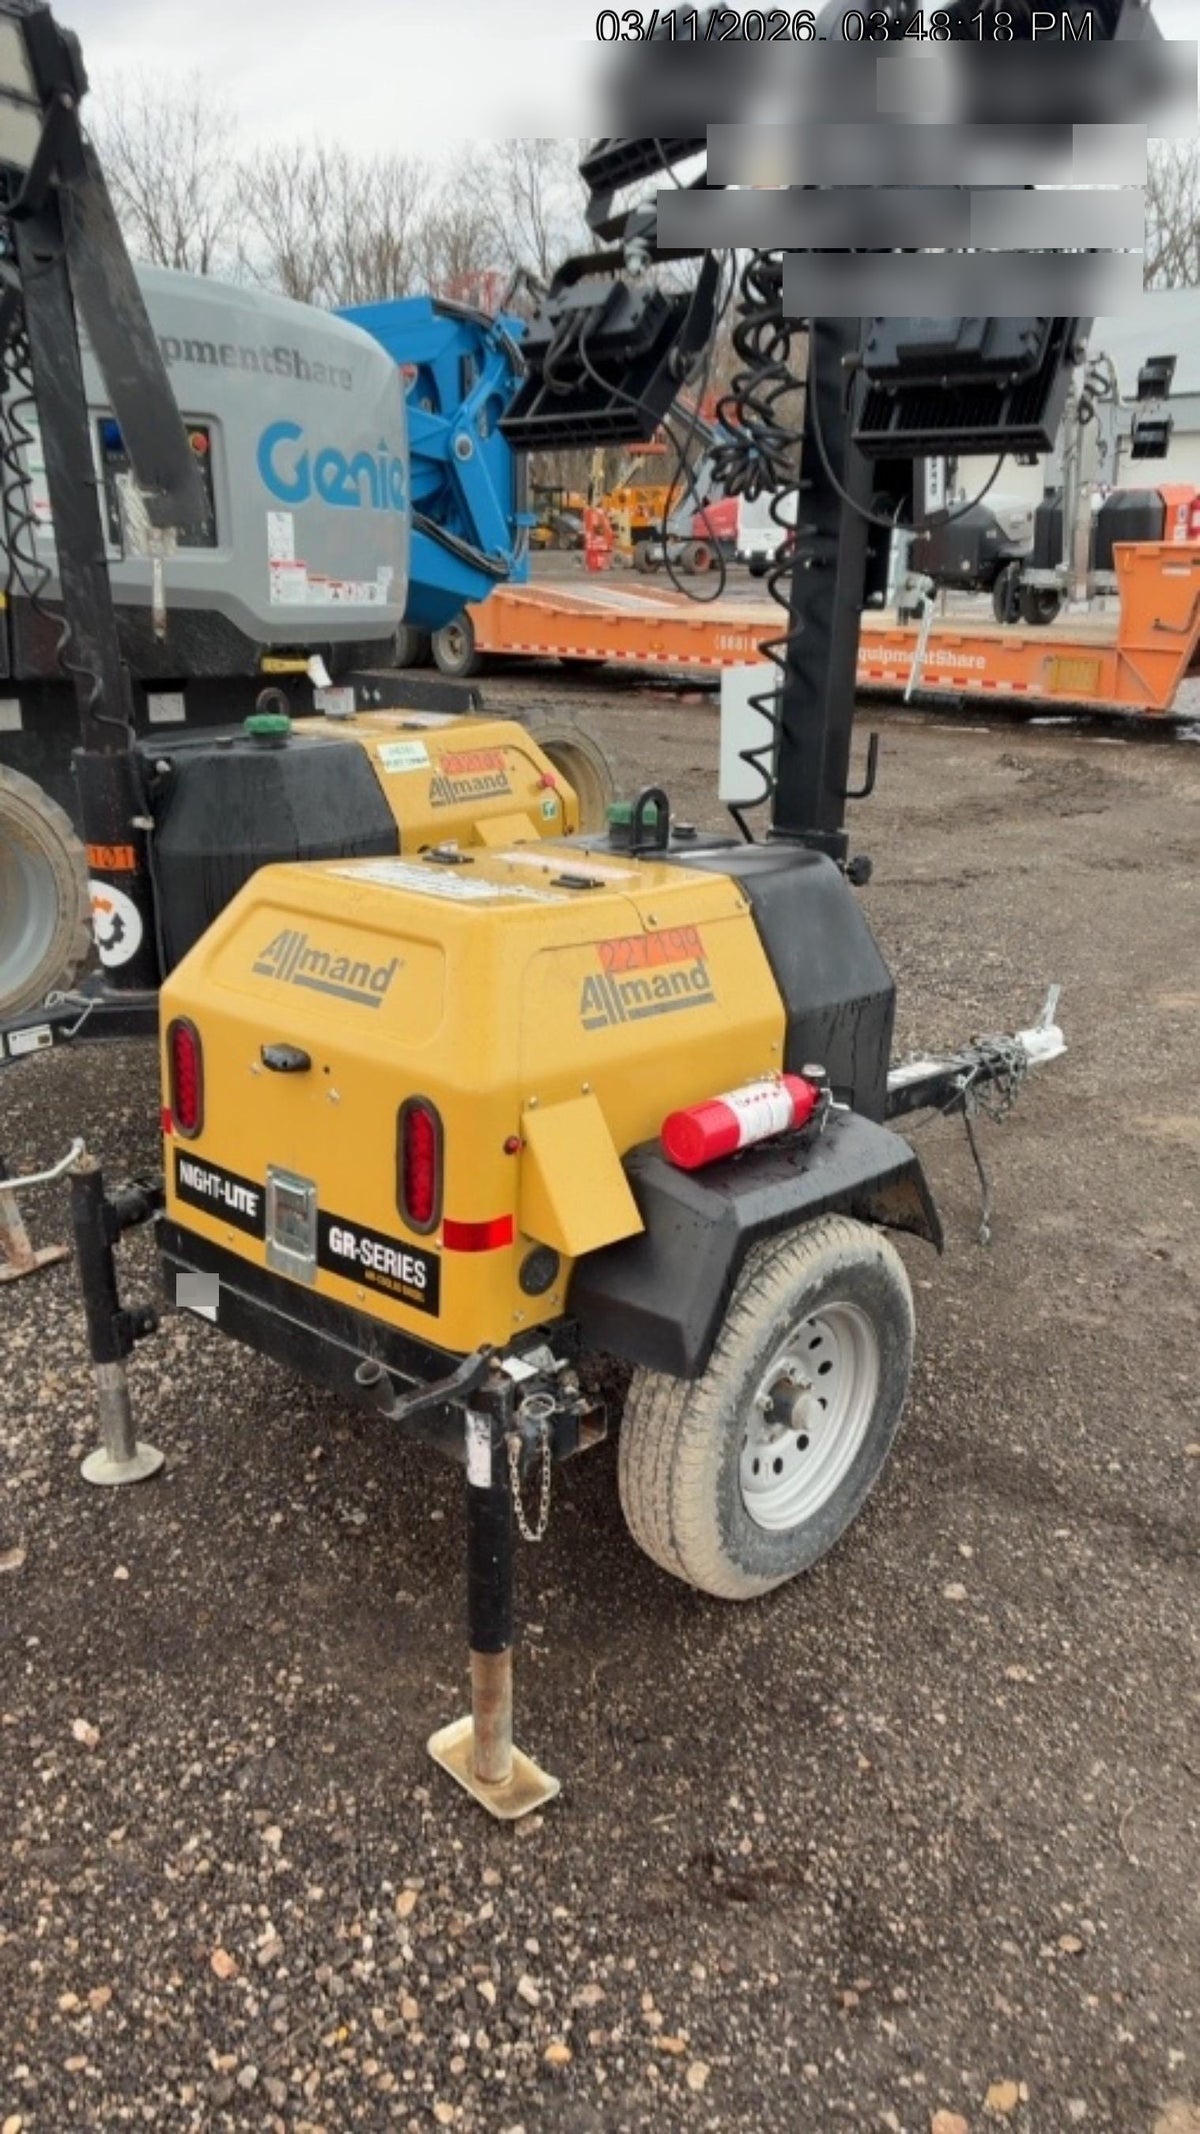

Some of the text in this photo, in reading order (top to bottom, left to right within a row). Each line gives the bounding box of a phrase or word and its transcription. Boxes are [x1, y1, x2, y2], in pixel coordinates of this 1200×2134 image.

[160, 335, 353, 391] pmentShare
[257, 420, 408, 511] Genie
[430, 770, 509, 805] Allmand
[258, 929, 397, 995] Allmand
[581, 957, 711, 1023] Allmand
[179, 1160, 259, 1218] NIGHT-LITE
[328, 1226, 428, 1289] GR-SERIES
